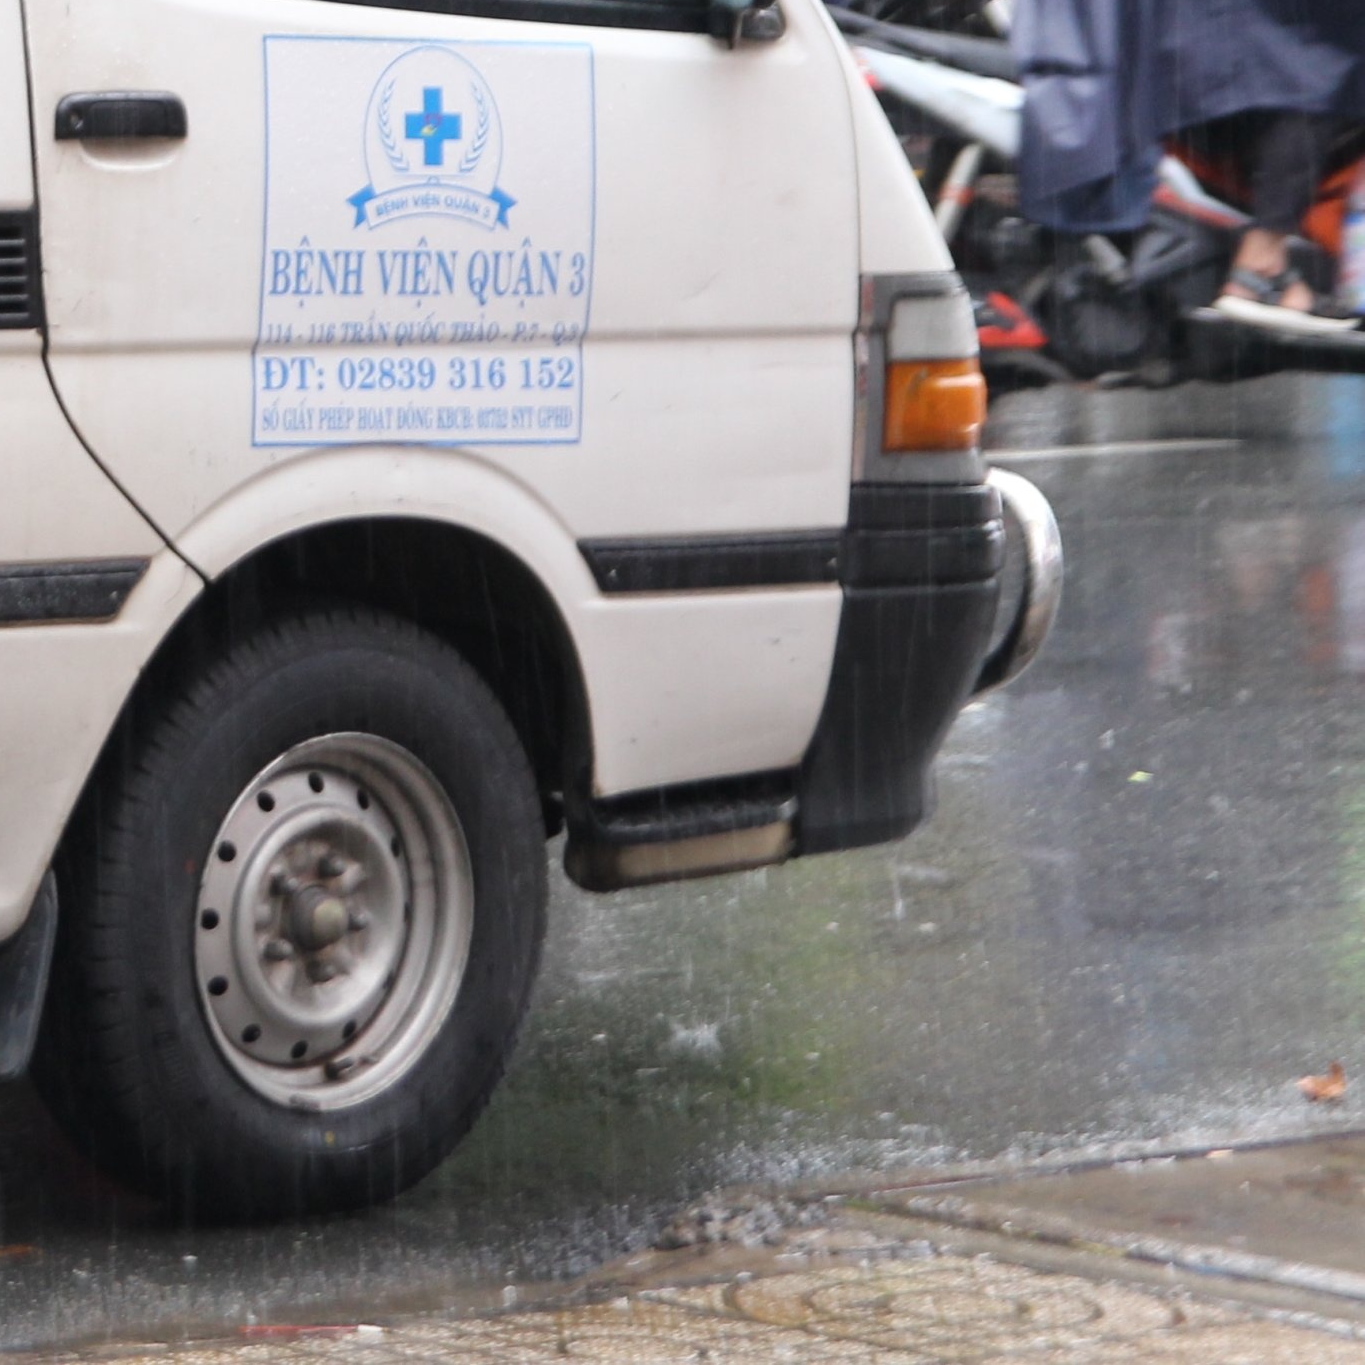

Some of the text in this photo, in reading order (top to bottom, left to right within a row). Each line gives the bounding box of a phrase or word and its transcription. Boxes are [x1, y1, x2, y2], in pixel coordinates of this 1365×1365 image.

[269, 236, 586, 308] BỆNH VIỆN QUẬN 3
[262, 357, 575, 391] ĐT: 02839 316 152
